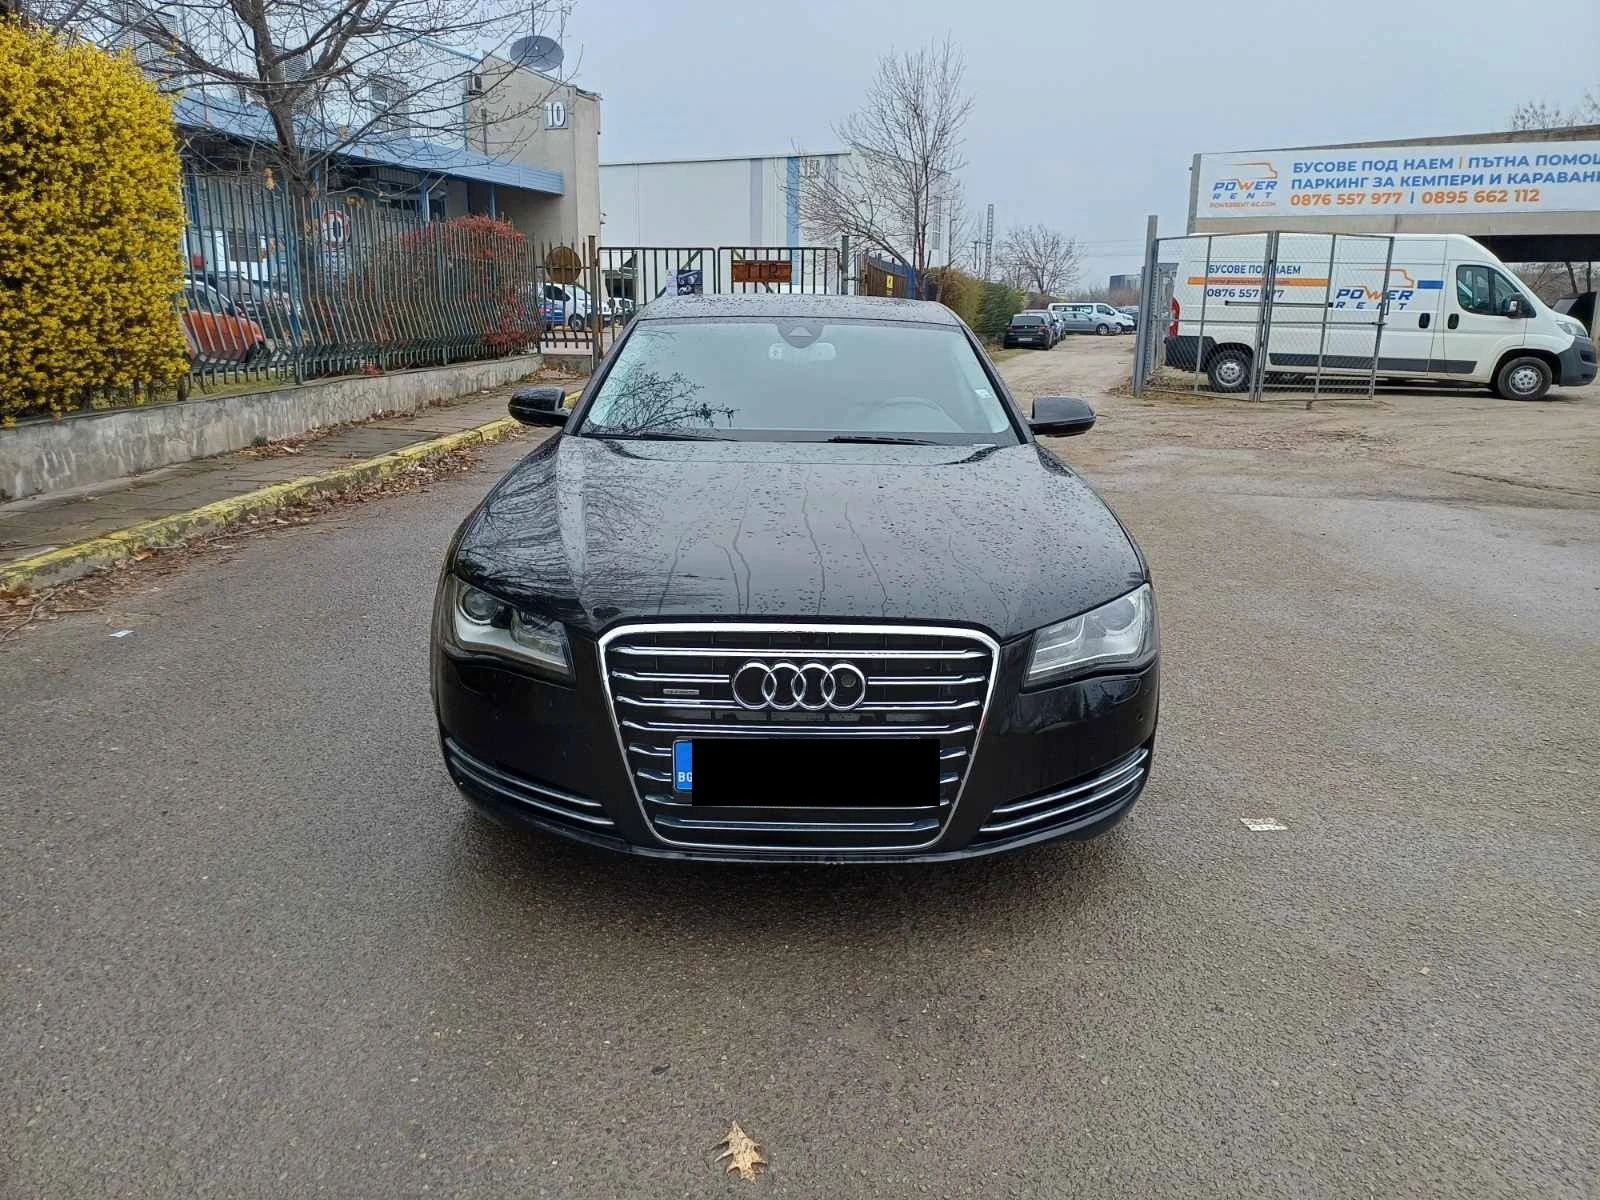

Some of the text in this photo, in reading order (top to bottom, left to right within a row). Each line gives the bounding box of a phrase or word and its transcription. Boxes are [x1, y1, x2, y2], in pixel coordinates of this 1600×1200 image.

[545, 101, 565, 127] 10
[1293, 161, 1357, 173] БУСОВЕ
[1361, 160, 1398, 172] ПОД
[1403, 158, 1454, 170] НАЕМ
[1468, 156, 1529, 168] ПЪТНА
[1213, 180, 1278, 191] POWER
[1291, 177, 1368, 189] ПАРКИНГ
[1372, 177, 1395, 187] ЗА
[1400, 175, 1483, 187] КЕМПЕРИ
[1489, 174, 1502, 185] И
[1212, 192, 1272, 200] RENT
[1290, 189, 1540, 206] 0876 557 977 0895 662 112
[1208, 264, 1246, 274] БУСОВЕ
[1207, 288, 1236, 298] 0876
[1238, 288, 1258, 298] 557
[1336, 288, 1414, 301] POWER
[678, 771, 692, 783] BG
